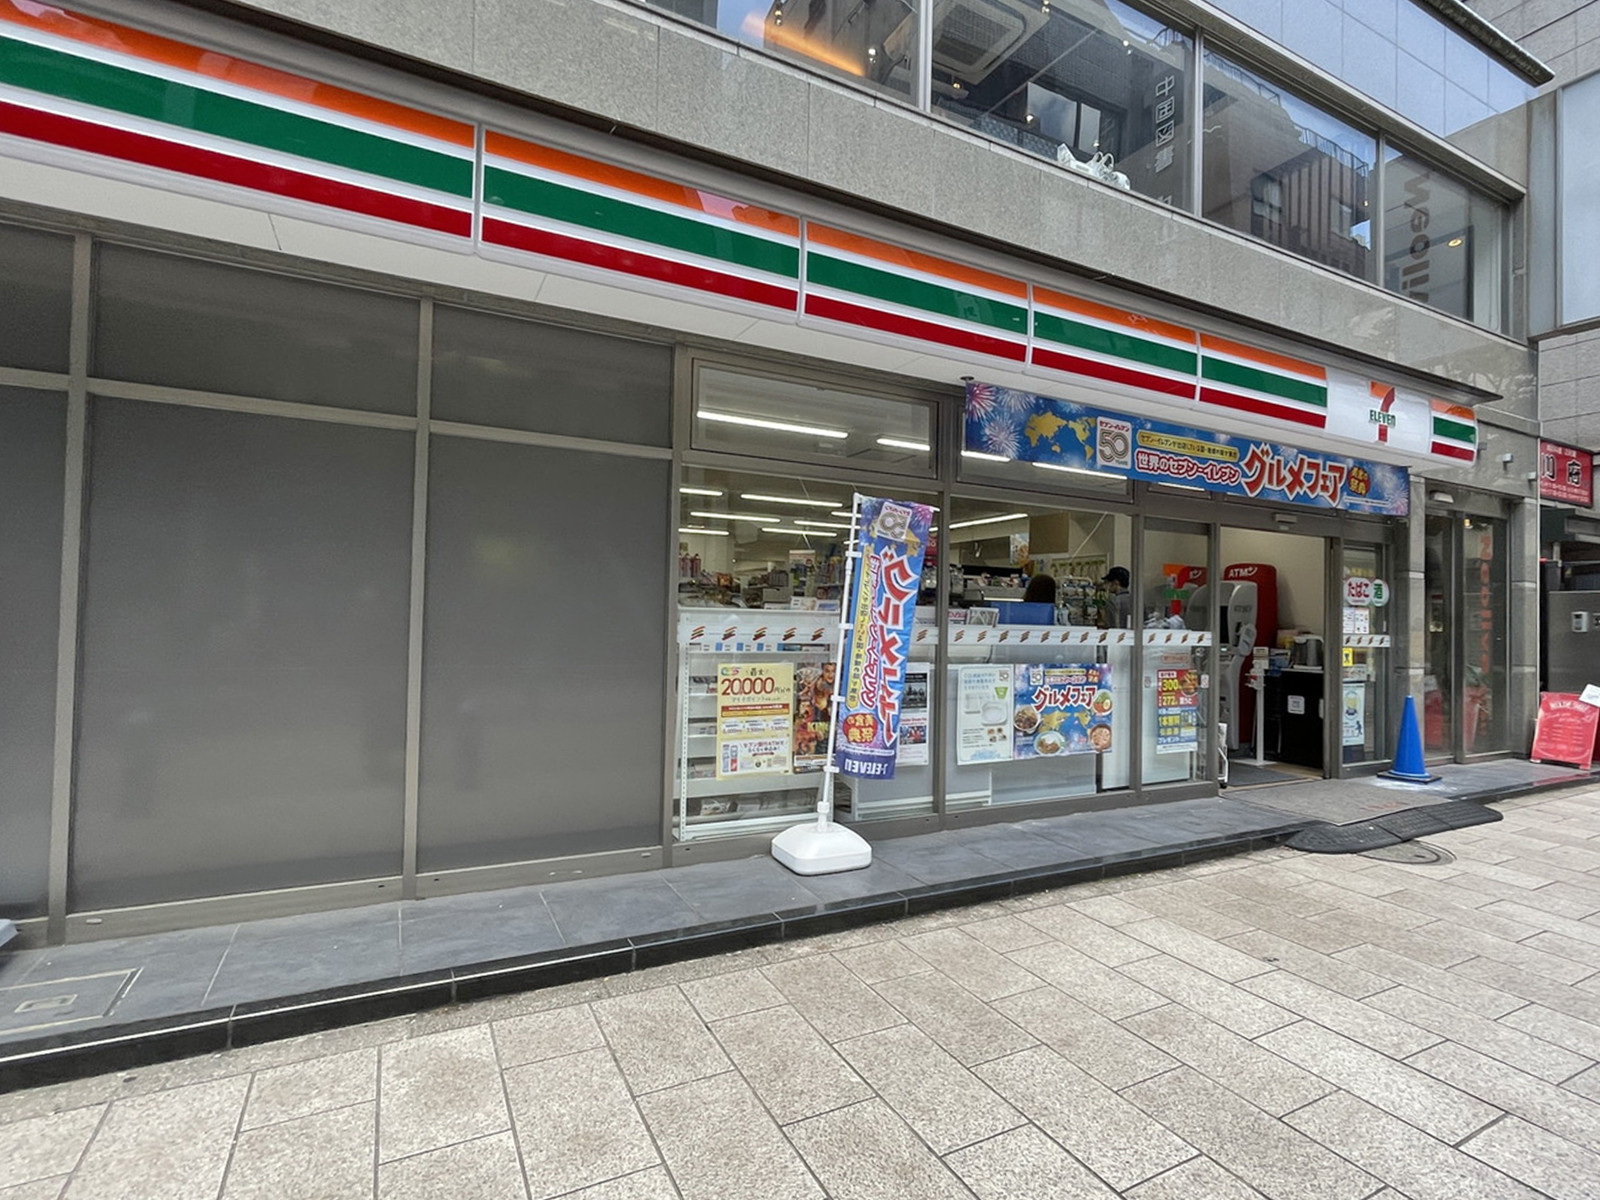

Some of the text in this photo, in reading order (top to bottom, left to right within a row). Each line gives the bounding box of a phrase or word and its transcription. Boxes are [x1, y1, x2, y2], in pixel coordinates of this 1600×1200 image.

[1099, 428, 1128, 462] 50
[1137, 450, 1240, 485] 世界のセブン-イレブン
[1243, 445, 1346, 505] グルメフェア
[1228, 568, 1248, 578] ATM
[1347, 581, 1370, 598] たばこ
[1373, 583, 1383, 599] 酒
[1034, 686, 1097, 711] グルメフェア
